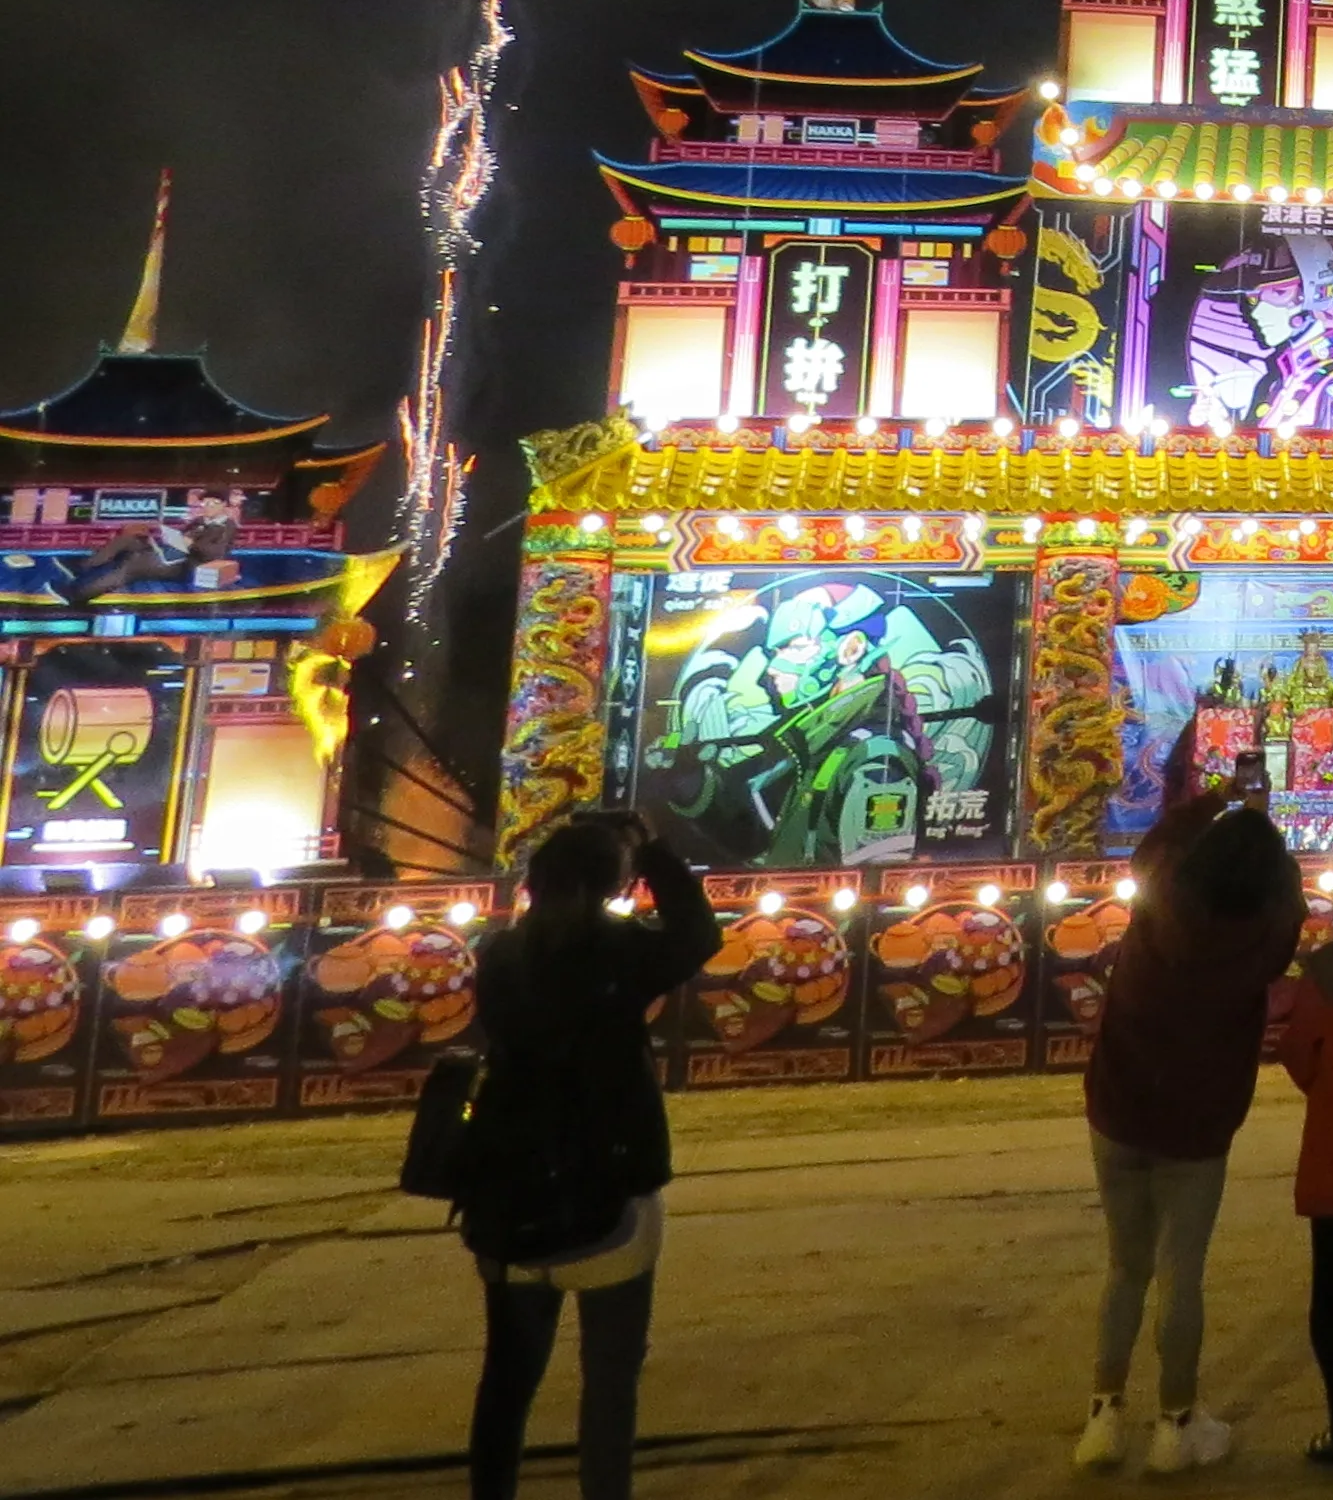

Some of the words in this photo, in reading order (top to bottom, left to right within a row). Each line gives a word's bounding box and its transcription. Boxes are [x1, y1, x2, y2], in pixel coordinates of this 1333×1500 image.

[808, 126, 854, 137] HAKKA
[100, 499, 160, 512] HAKKA
[925, 790, 989, 822] 拓荒
